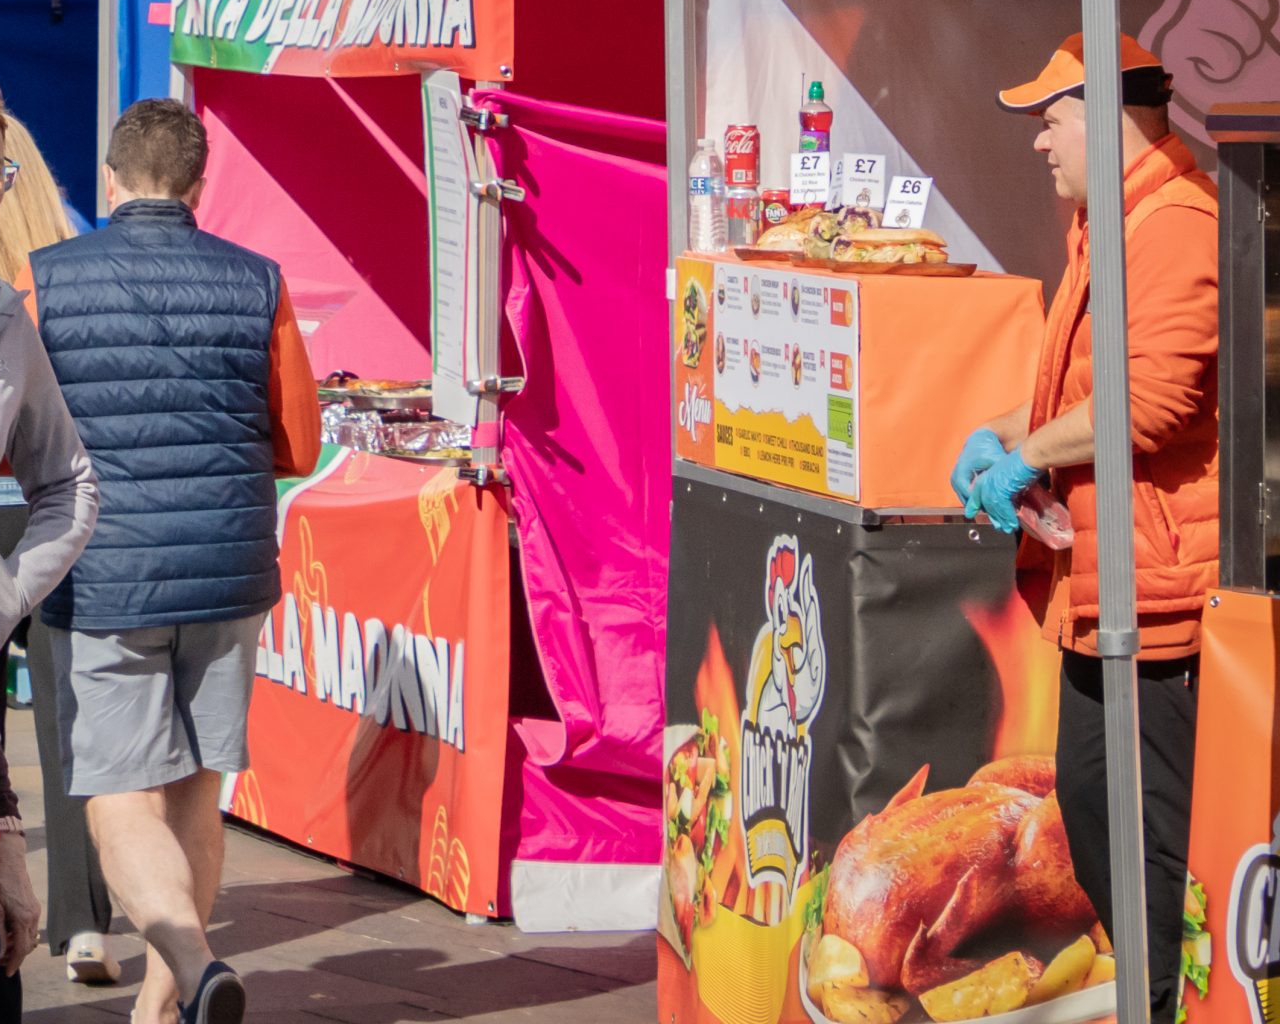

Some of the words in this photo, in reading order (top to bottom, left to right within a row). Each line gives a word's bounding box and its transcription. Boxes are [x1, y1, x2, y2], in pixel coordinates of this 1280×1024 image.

[800, 156, 821, 170] £7
[854, 159, 876, 174] £7
[901, 180, 922, 194] £6
[679, 382, 711, 442] Menu
[717, 424, 733, 446] SAUCES
